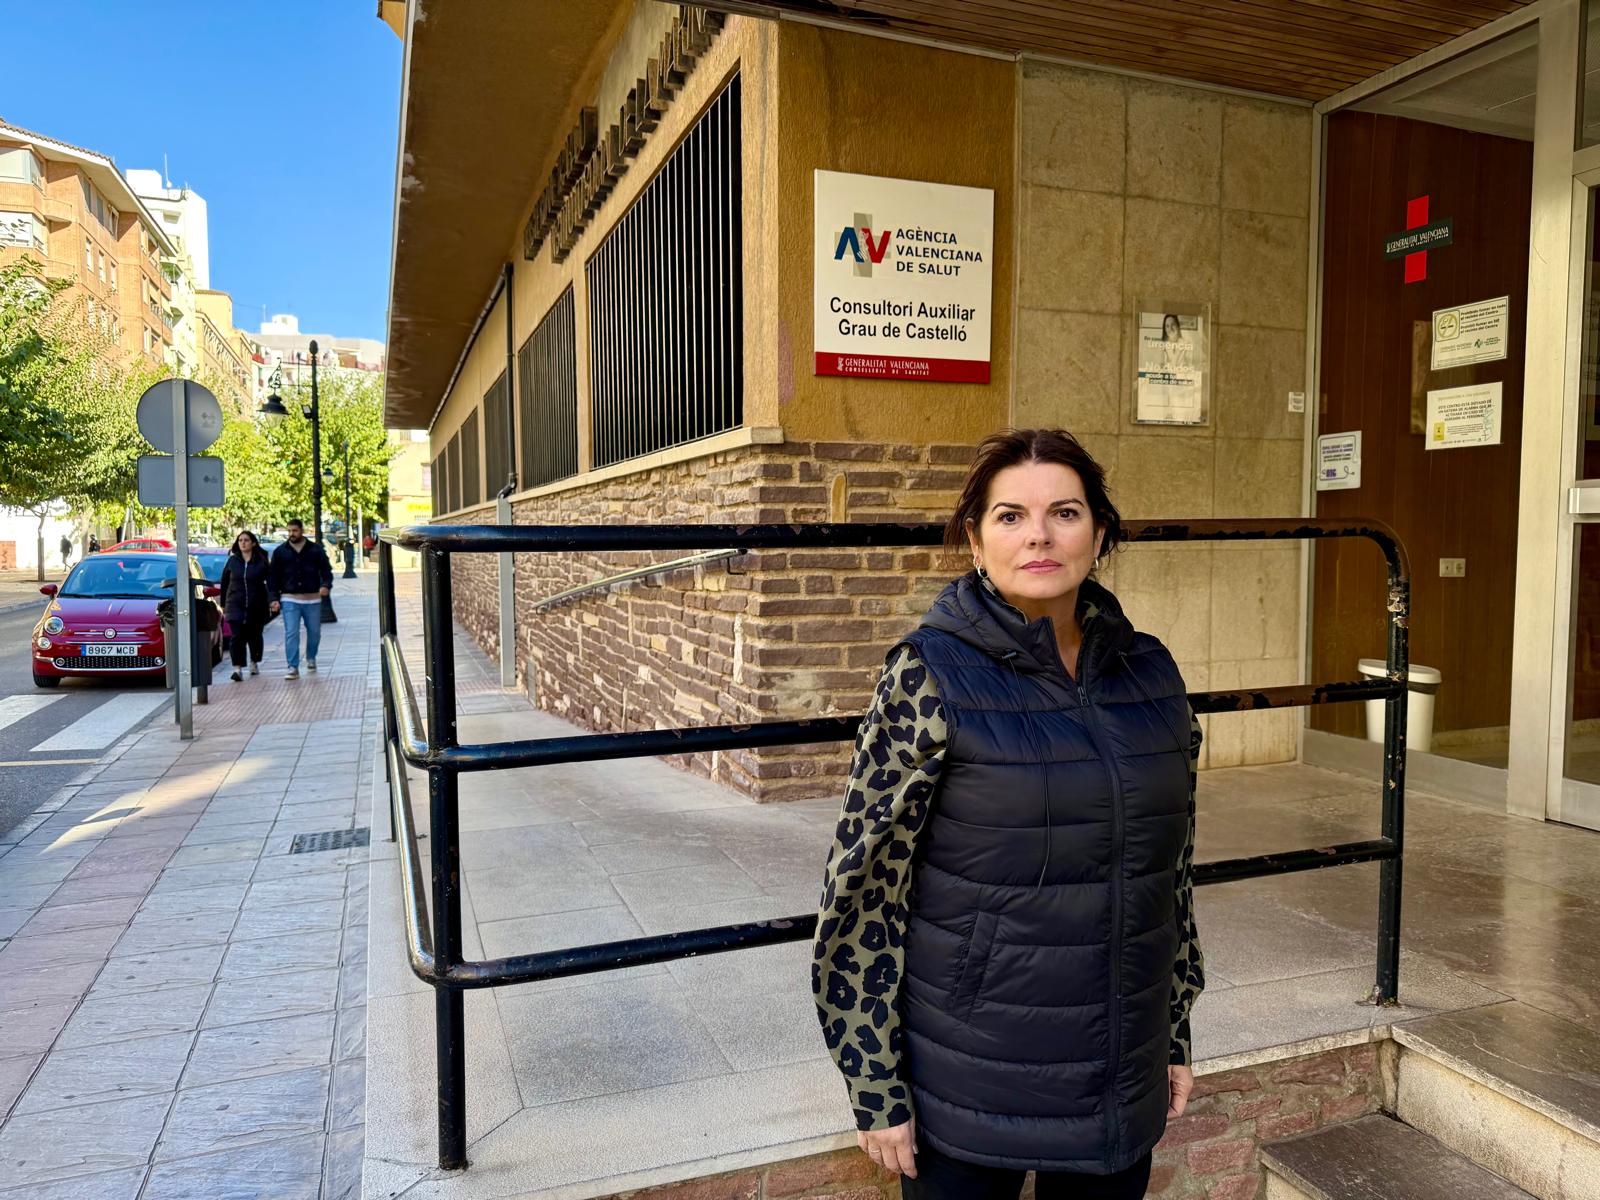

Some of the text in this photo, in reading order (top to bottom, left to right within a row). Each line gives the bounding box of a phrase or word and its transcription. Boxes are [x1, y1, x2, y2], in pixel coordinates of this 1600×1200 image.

[896, 227, 957, 244] AGÈNCIA
[896, 246, 983, 262] VALENCIANA
[896, 262, 961, 276] DE SALUT
[830, 297, 975, 321] Consultori Auxiliar
[839, 319, 967, 341] Grau de Castelló
[846, 358, 929, 370] GENERALITAT VALENCIANA
[88, 646, 135, 655] 8967 MCB
